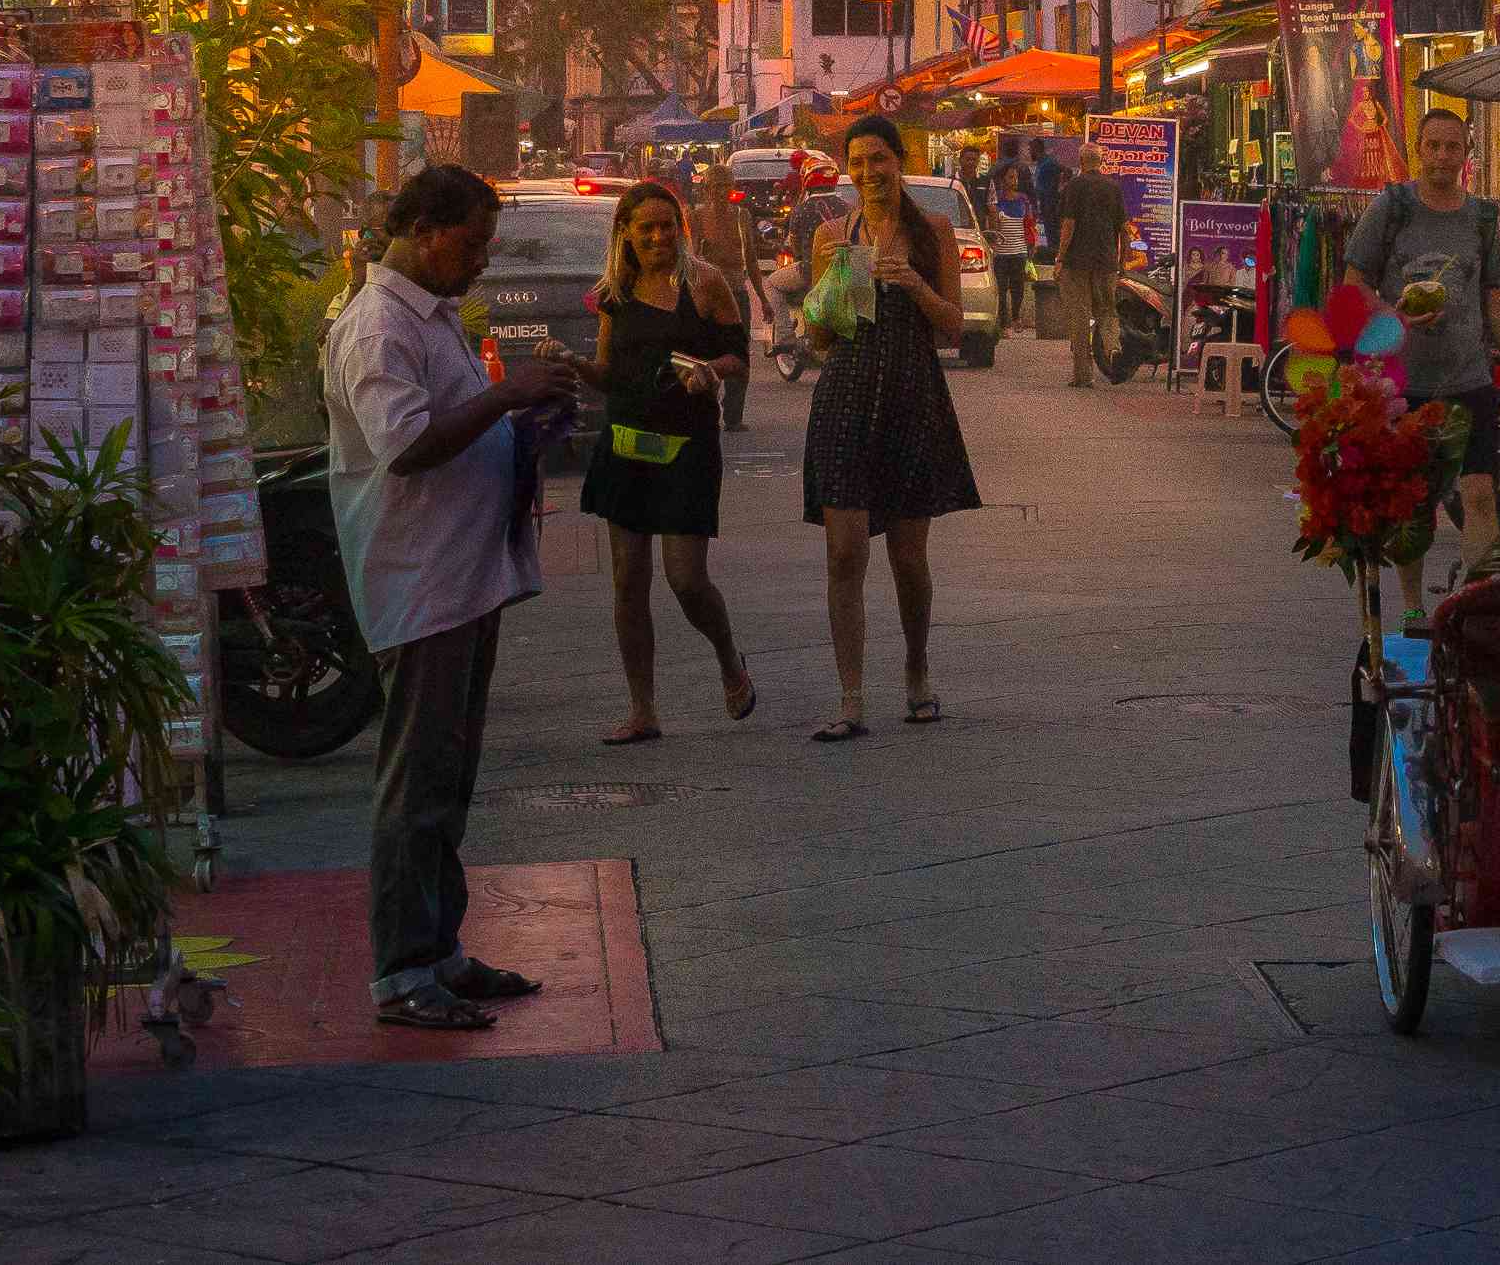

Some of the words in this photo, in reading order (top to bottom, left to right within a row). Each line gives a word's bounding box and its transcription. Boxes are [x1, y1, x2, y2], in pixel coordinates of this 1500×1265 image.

[1299, 2, 1334, 12] Langga
[1300, 13, 1330, 23] Ready
[1332, 12, 1357, 21] Made
[1101, 121, 1165, 140] DEVAN
[489, 324, 548, 339] PMD1629
